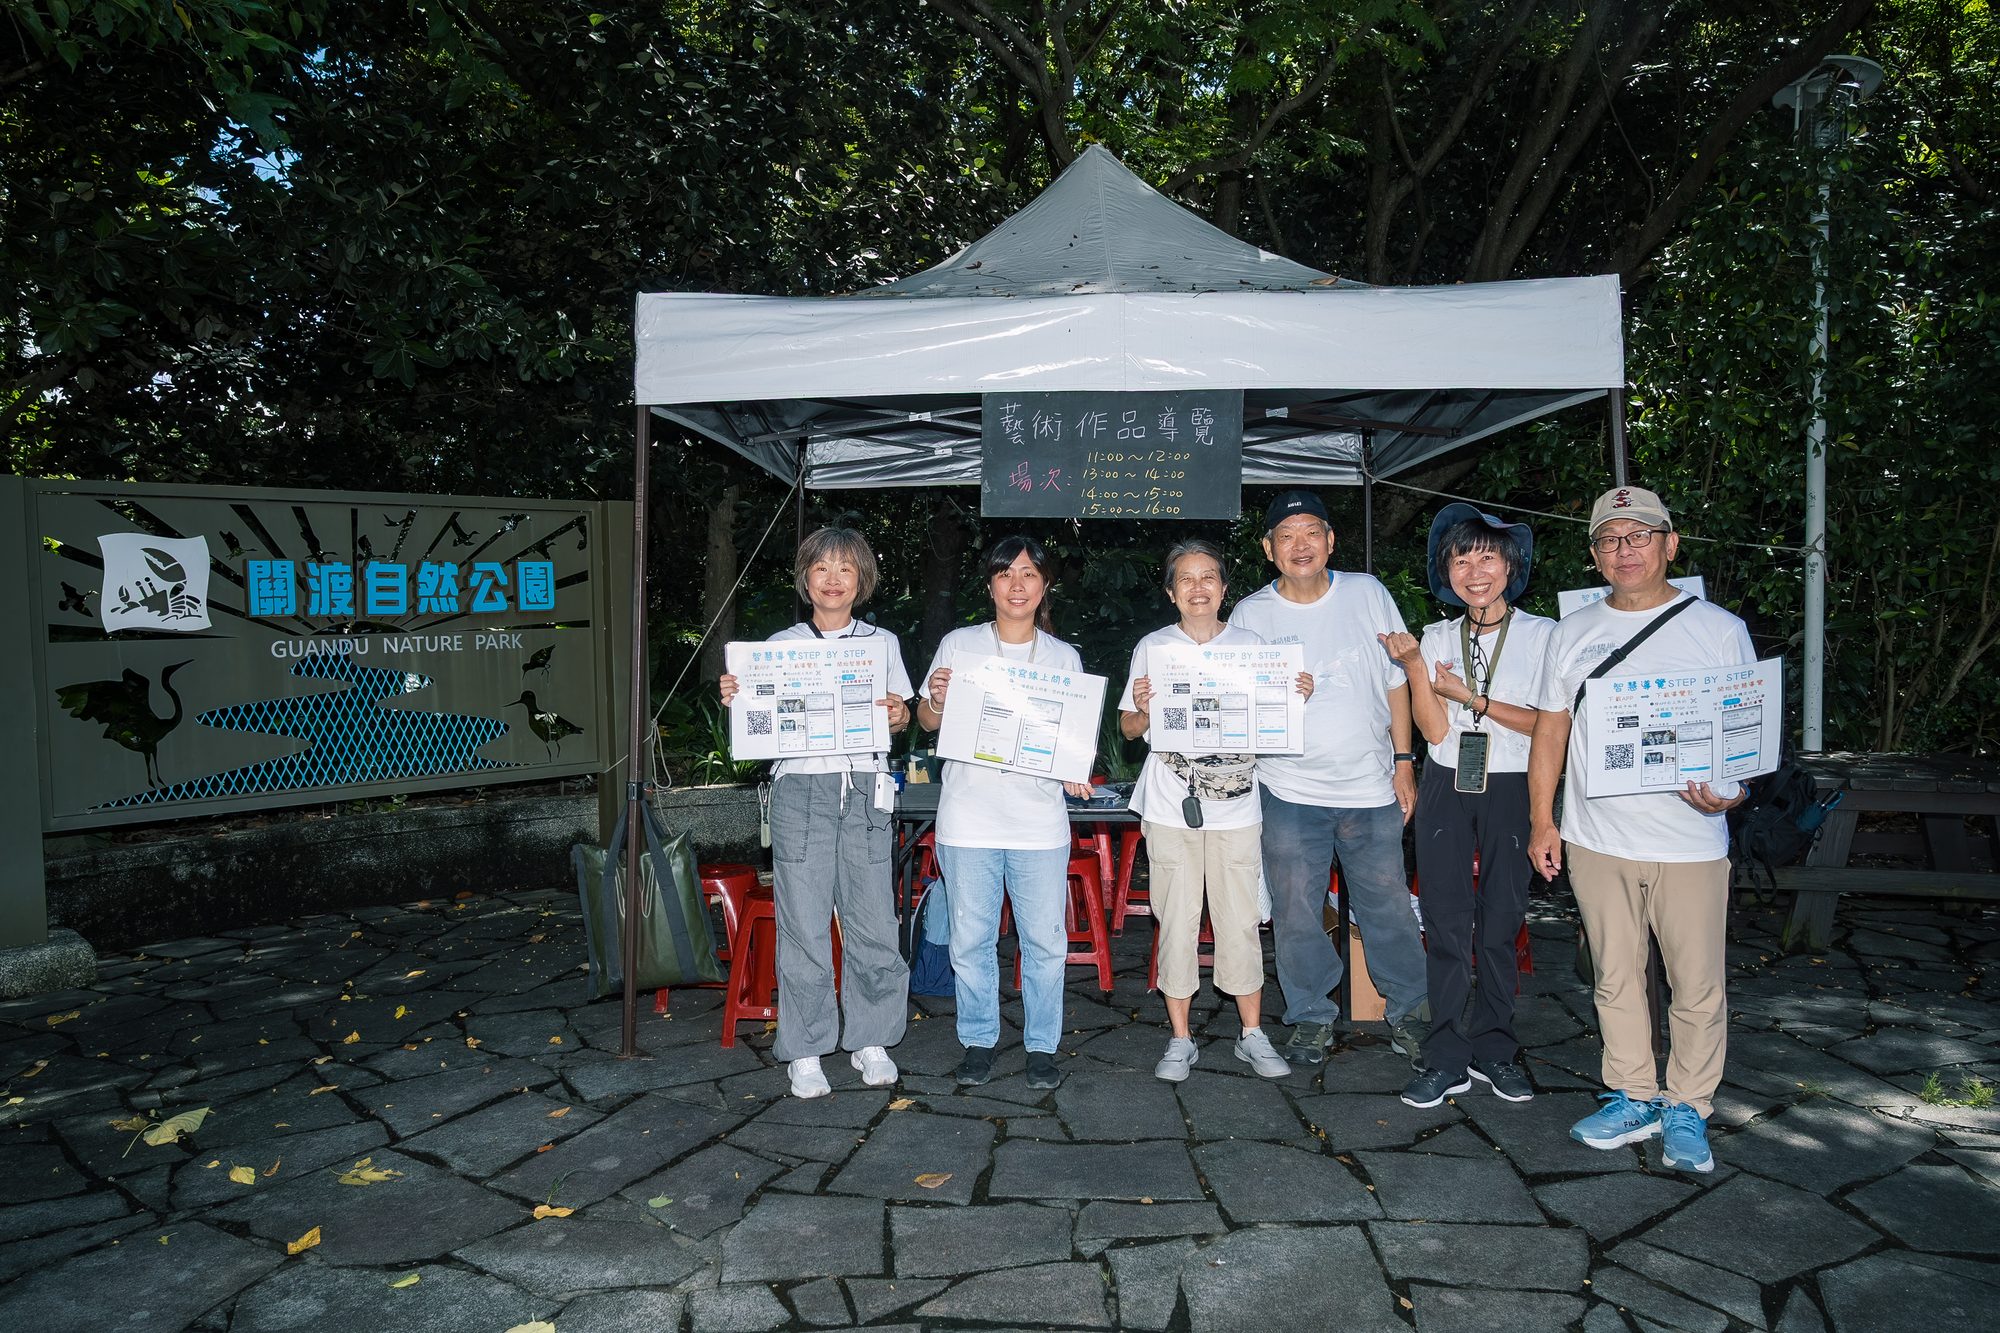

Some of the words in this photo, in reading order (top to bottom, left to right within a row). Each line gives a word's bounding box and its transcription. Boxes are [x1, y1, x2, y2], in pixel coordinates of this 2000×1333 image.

[999, 402, 1216, 446] 藝術作品導覽
[248, 559, 555, 617] 關渡自然公園
[270, 637, 369, 658] GUANDU
[383, 634, 463, 653] NATURE
[475, 632, 523, 650] PARK
[826, 650, 838, 659] BY
[843, 649, 866, 658] STEP
[1241, 652, 1253, 660] BY
[1258, 651, 1281, 660] STEP
[1704, 675, 1718, 685] BY
[1726, 670, 1754, 682] STEP
[1623, 1119, 1640, 1128] FILA
